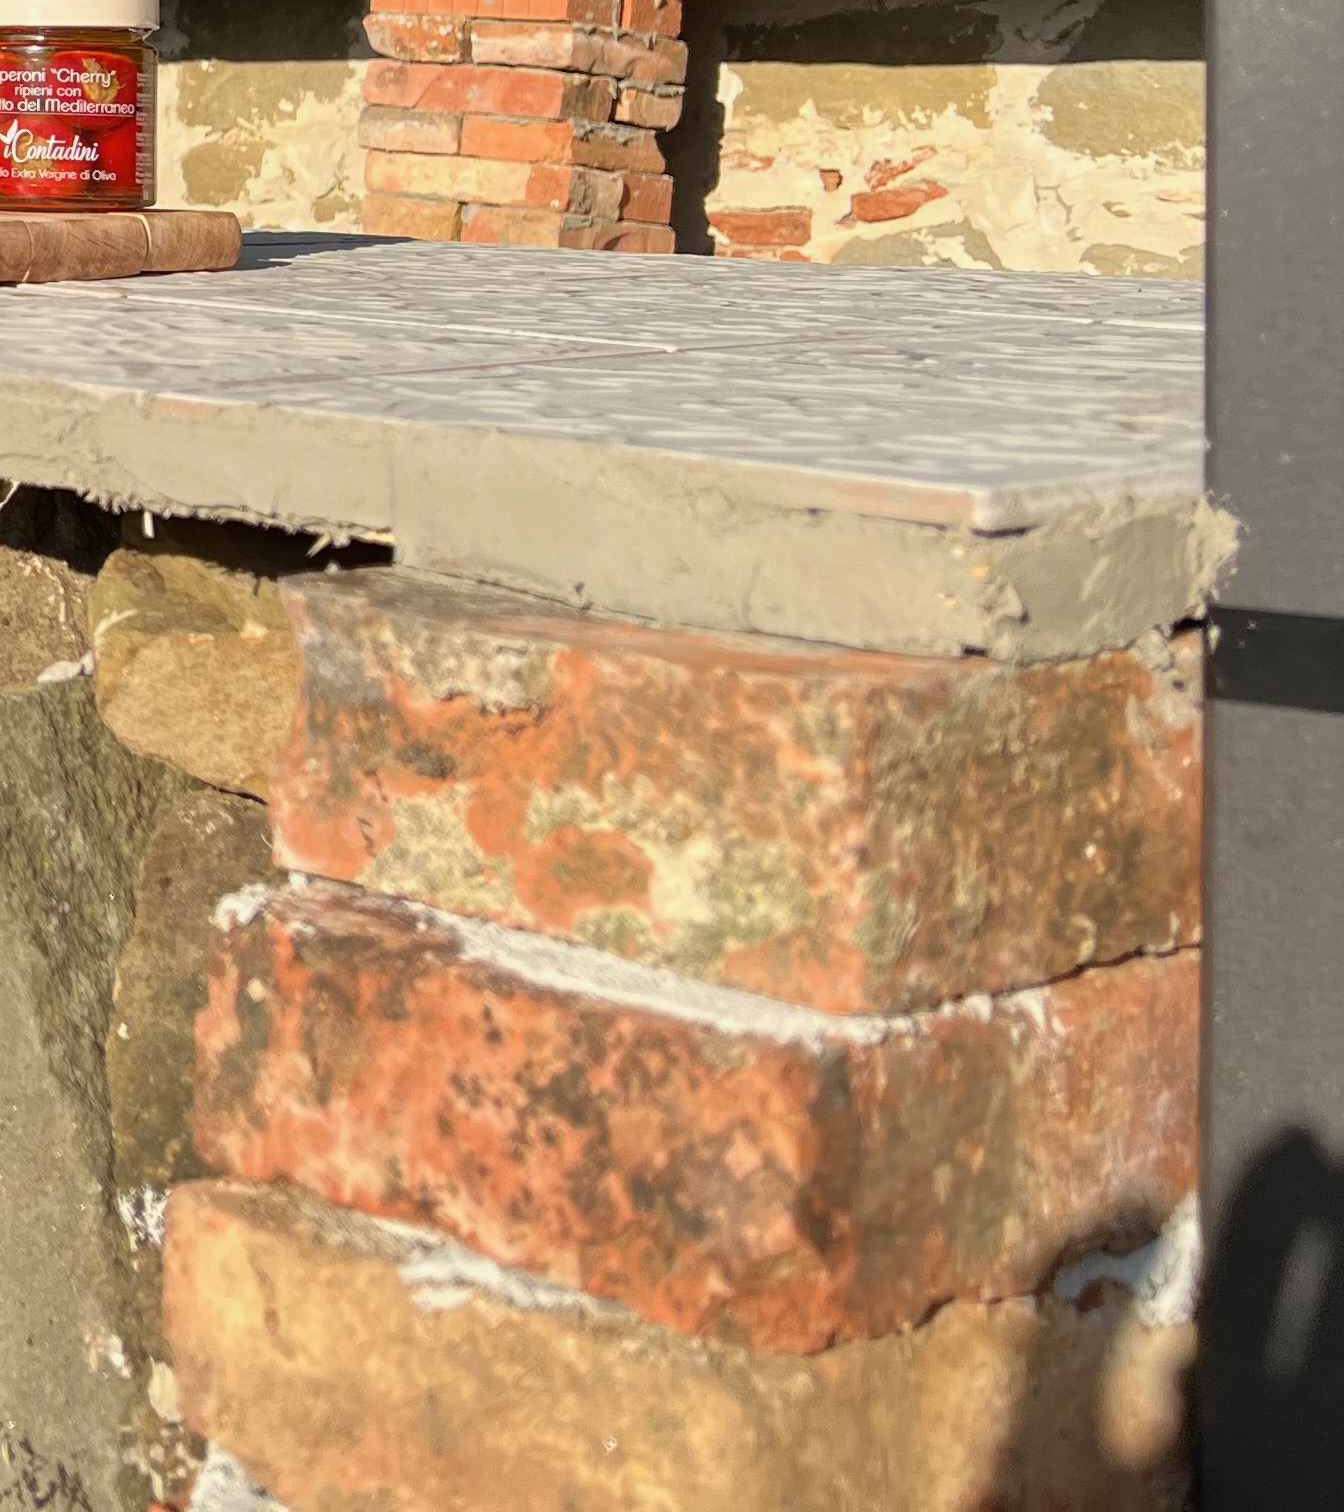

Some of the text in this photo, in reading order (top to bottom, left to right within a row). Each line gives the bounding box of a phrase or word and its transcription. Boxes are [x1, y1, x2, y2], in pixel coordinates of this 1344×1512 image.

[56, 87, 82, 97] con
[17, 98, 40, 112] del
[44, 98, 135, 115] Mediterraneo
[39, 169, 78, 182] Vergine
[79, 170, 91, 180] di
[92, 170, 118, 182] Oliva
